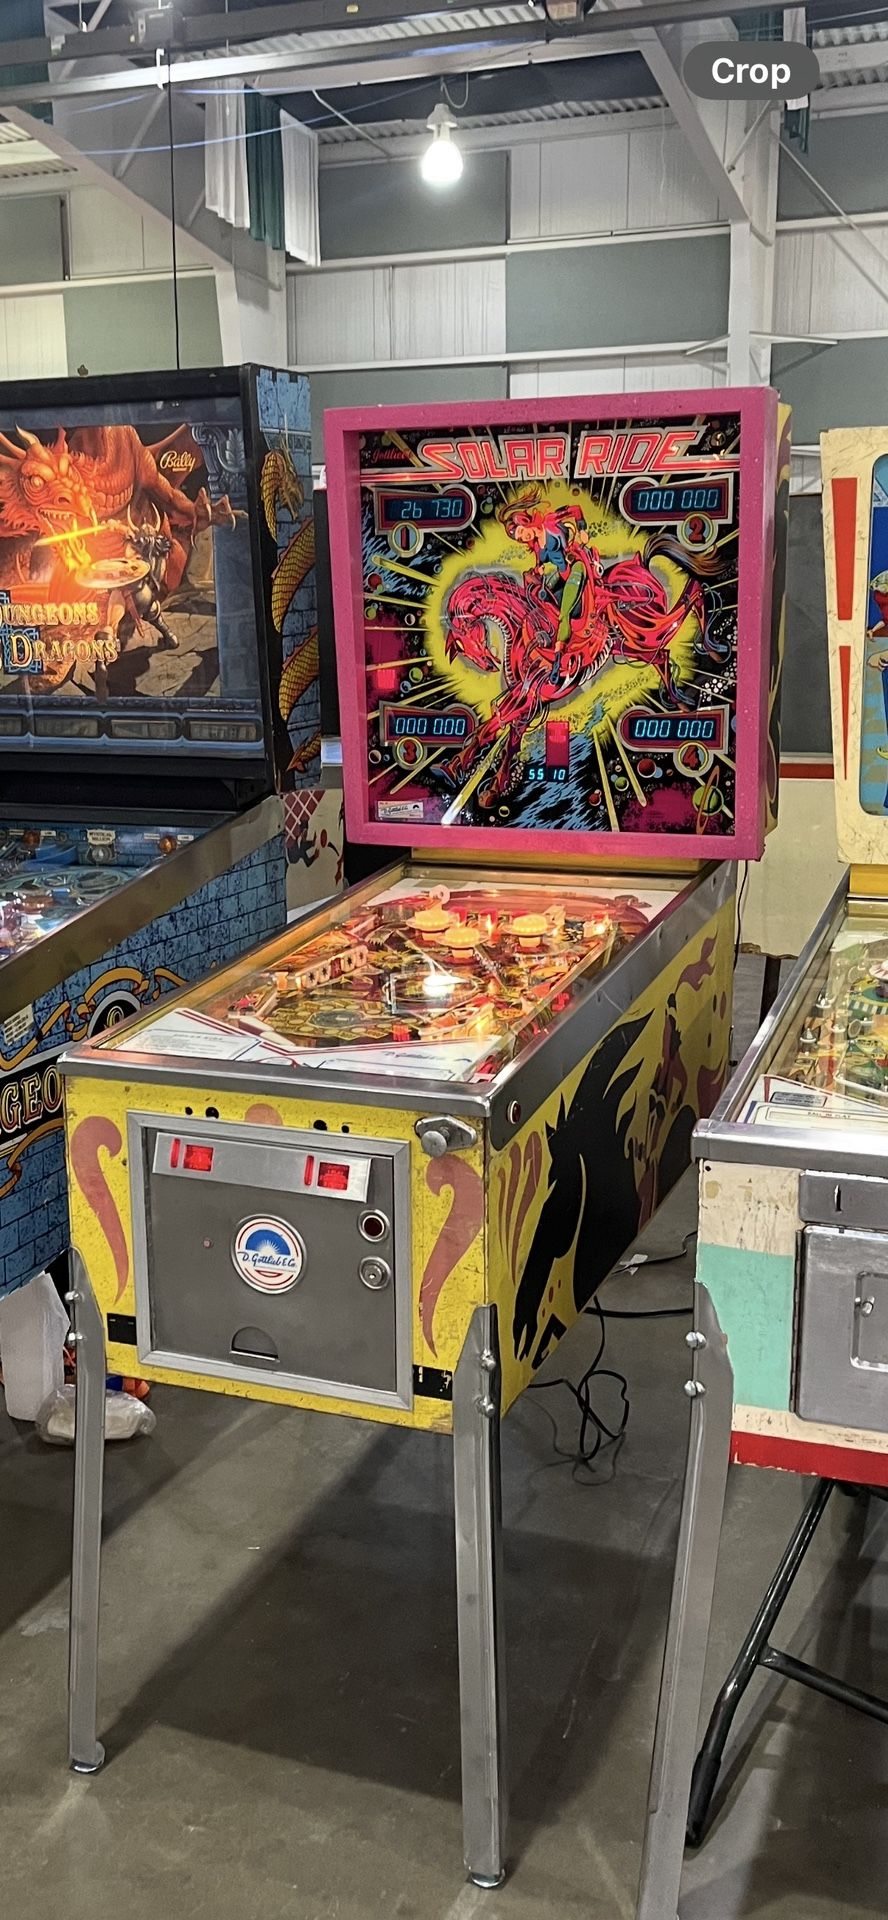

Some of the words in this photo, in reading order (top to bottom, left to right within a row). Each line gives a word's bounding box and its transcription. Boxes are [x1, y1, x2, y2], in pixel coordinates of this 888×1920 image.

[160, 450, 196, 472] Bally
[421, 438, 566, 480] SOLAR
[578, 431, 700, 474] RIDE
[401, 501, 422, 519] 26
[431, 499, 463, 517] 730
[637, 490, 675, 511] 000
[681, 488, 719, 510] 000
[400, 525, 410, 551] 1
[688, 516, 706, 544] 2
[0, 602, 99, 626] UNGEONS
[395, 717, 427, 734] 000
[433, 718, 466, 736] 000
[634, 719, 671, 738] 000
[677, 720, 714, 739] 000
[402, 741, 417, 763] 3
[682, 745, 699, 770] 4
[553, 769, 567, 781] 10
[0, 1064, 63, 1134] GEO
[252, 1253, 282, 1267] Gottlieb
